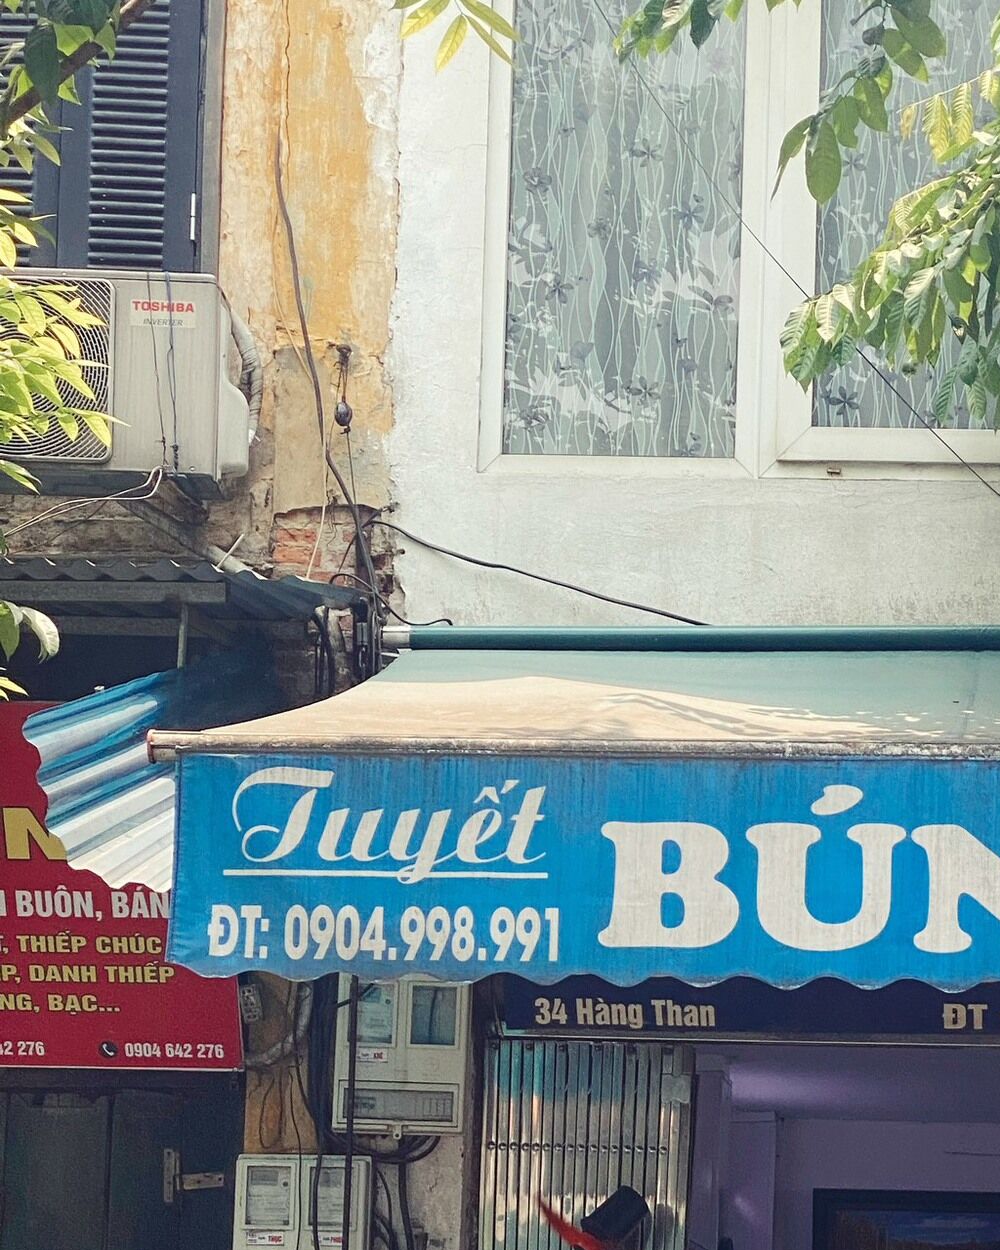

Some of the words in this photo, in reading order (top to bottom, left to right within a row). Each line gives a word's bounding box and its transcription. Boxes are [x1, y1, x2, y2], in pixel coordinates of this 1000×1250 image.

[132, 301, 194, 313] TOSHIBA
[143, 318, 184, 326] INVERTER
[232, 766, 547, 884] Tuyết
[15, 885, 103, 921] BUÔN,
[111, 886, 172, 919] BÁN
[16, 930, 87, 953] THIẾP
[95, 933, 163, 954] CHÚC
[207, 903, 268, 957] ĐT:
[284, 904, 559, 962] 0904.998.991
[29, 964, 97, 983] DANH
[104, 960, 175, 983] THIẾP
[534, 997, 568, 1025] 34
[575, 997, 643, 1029] Hàng
[651, 999, 716, 1027] Than
[17, 1041, 45, 1056] 276
[124, 1042, 162, 1058] 0904
[165, 1043, 193, 1058] 642
[197, 1044, 224, 1059] 276
